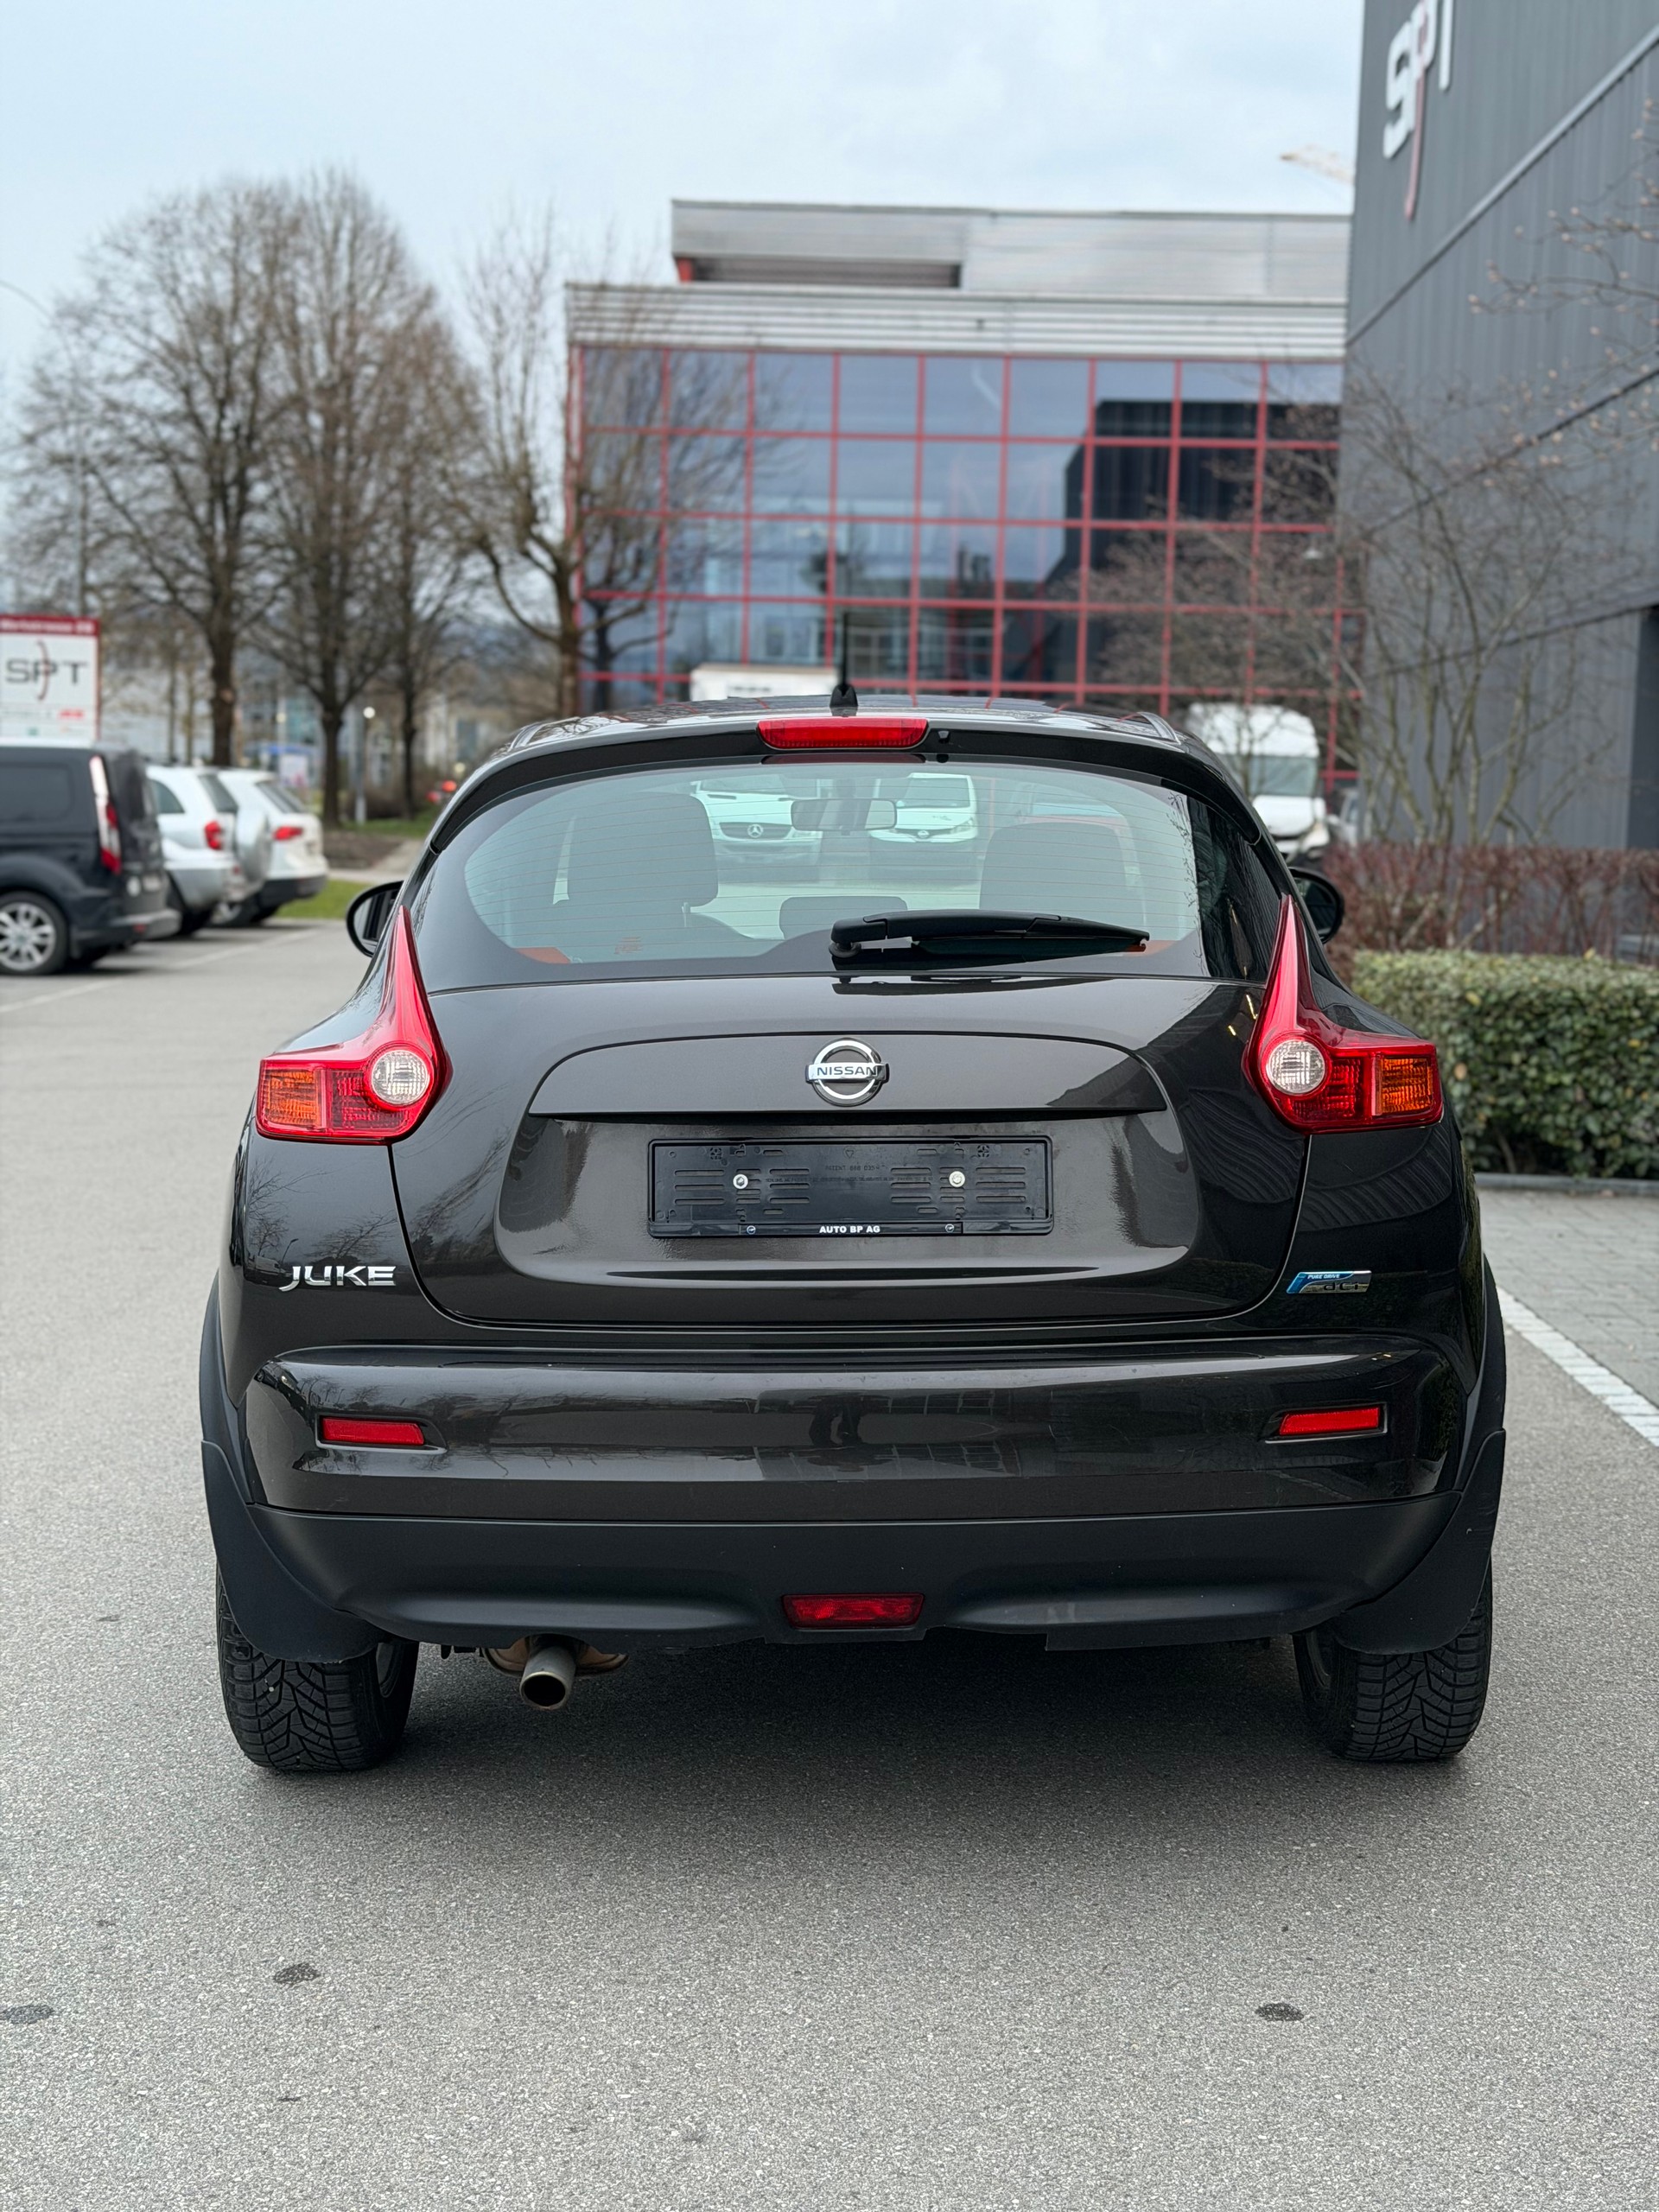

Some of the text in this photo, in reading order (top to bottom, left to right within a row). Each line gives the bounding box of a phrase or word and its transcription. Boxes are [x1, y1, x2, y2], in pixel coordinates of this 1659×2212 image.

[5, 658, 88, 684] SPT
[817, 1066, 878, 1076] NISSAN
[819, 1225, 880, 1234] AUTO BP AG
[278, 1266, 397, 1292] JUKE
